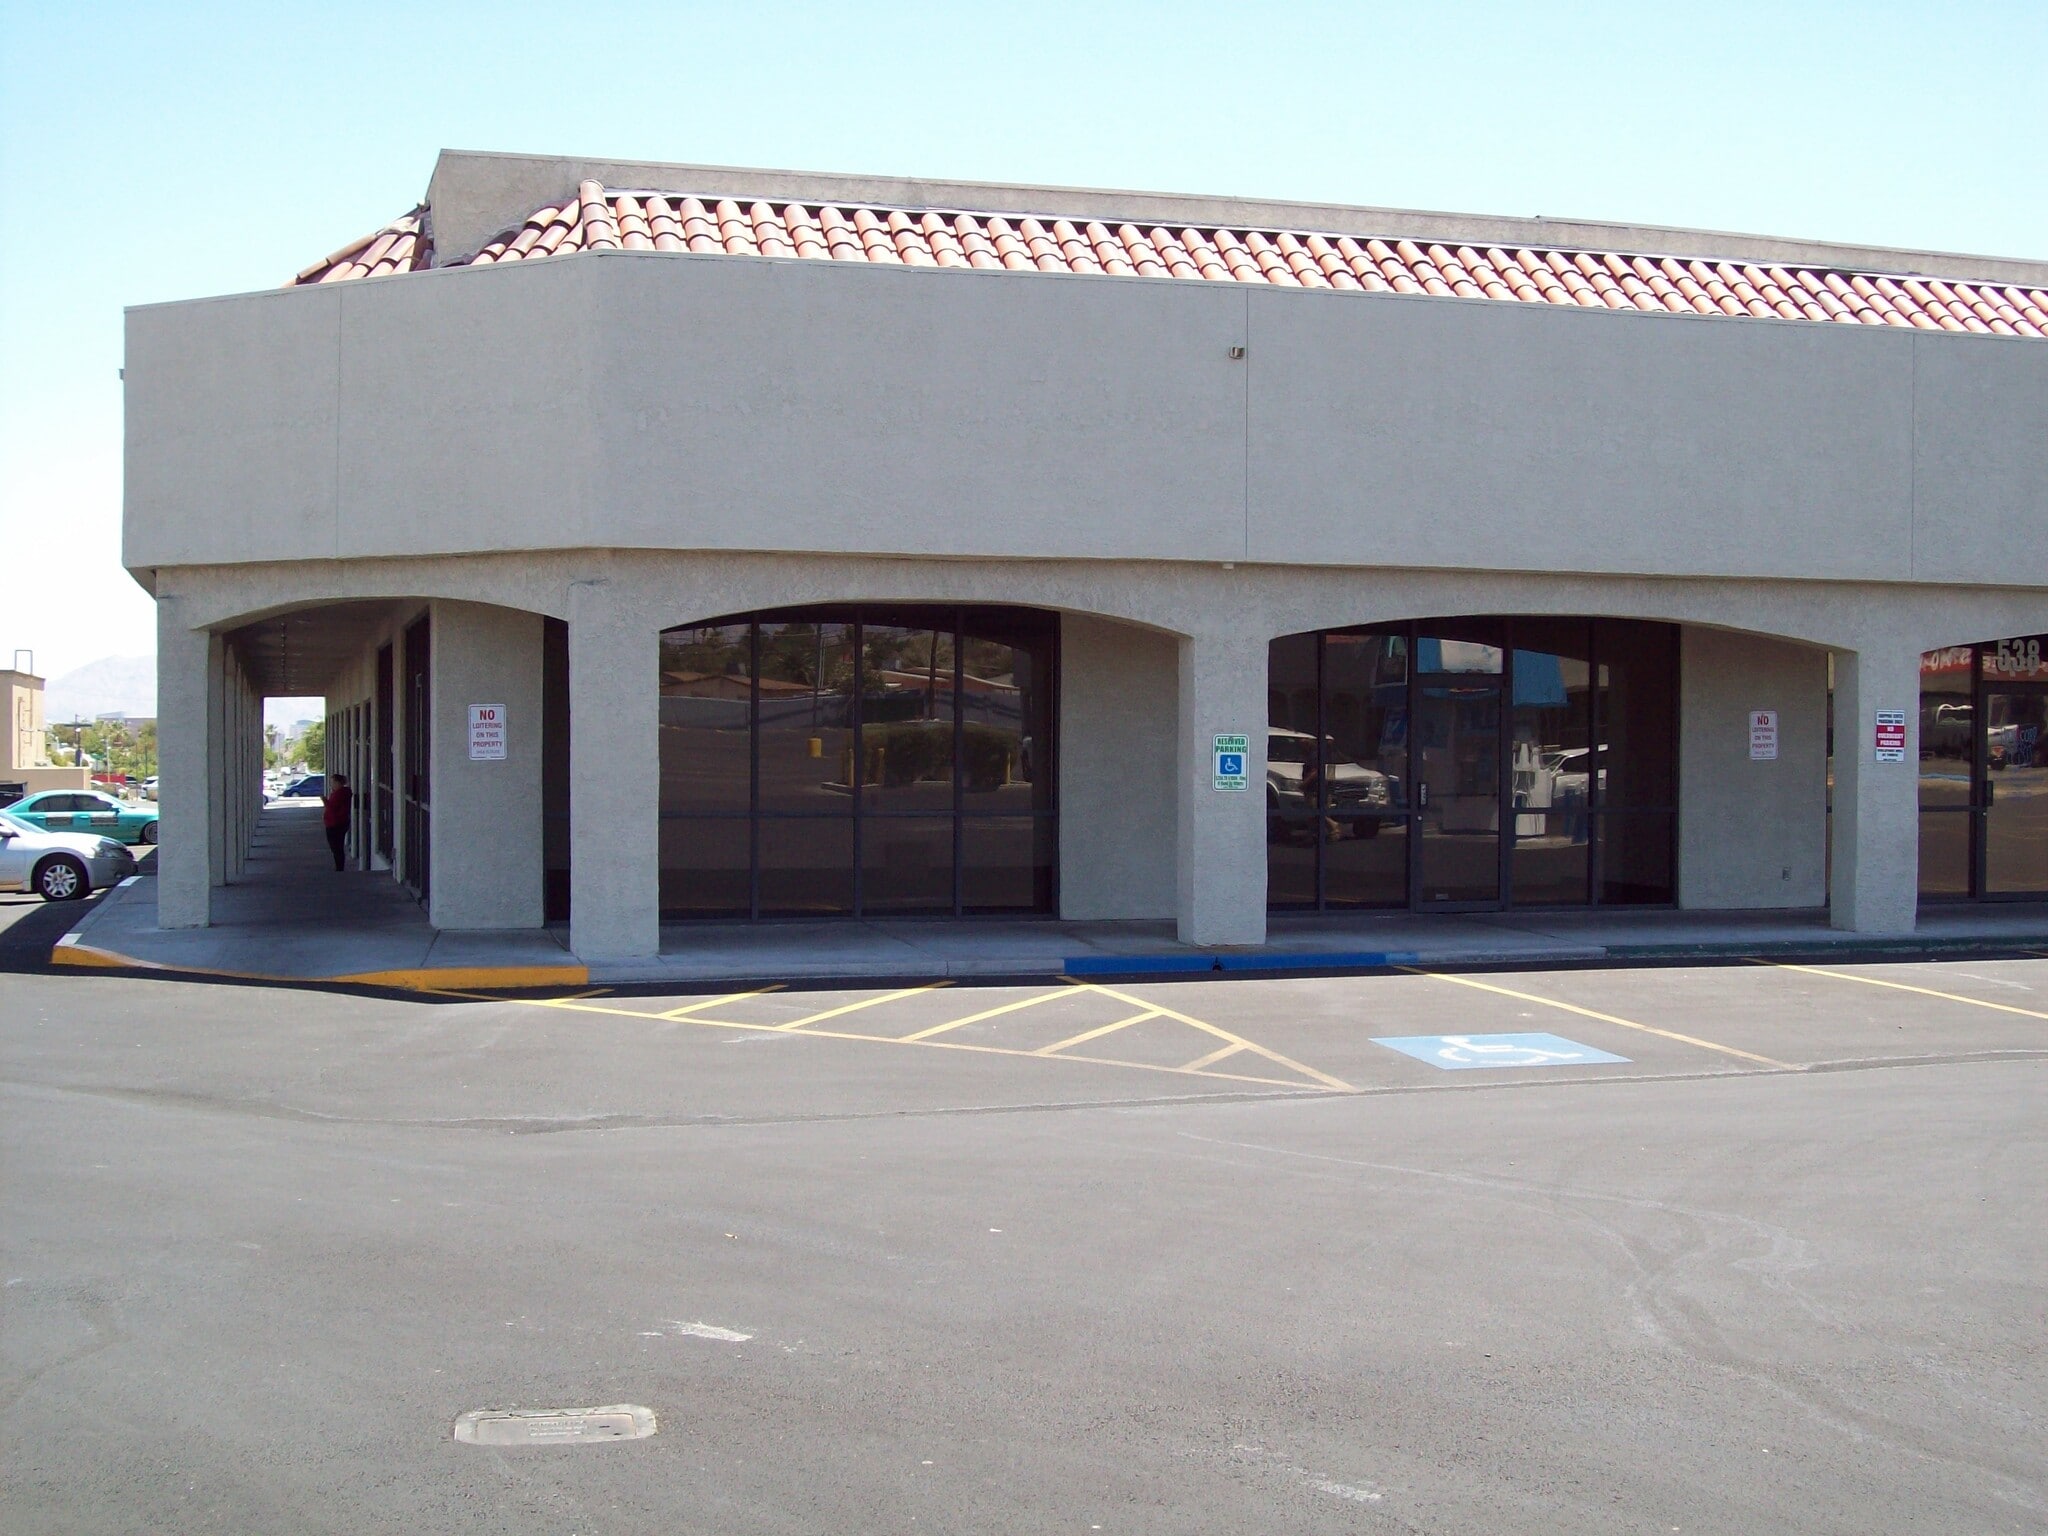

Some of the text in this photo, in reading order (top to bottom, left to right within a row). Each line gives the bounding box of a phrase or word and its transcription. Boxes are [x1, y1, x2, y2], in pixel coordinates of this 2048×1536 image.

[1997, 639, 2040, 673] 538
[480, 710, 495, 720] NO
[1757, 716, 1769, 725] NO
